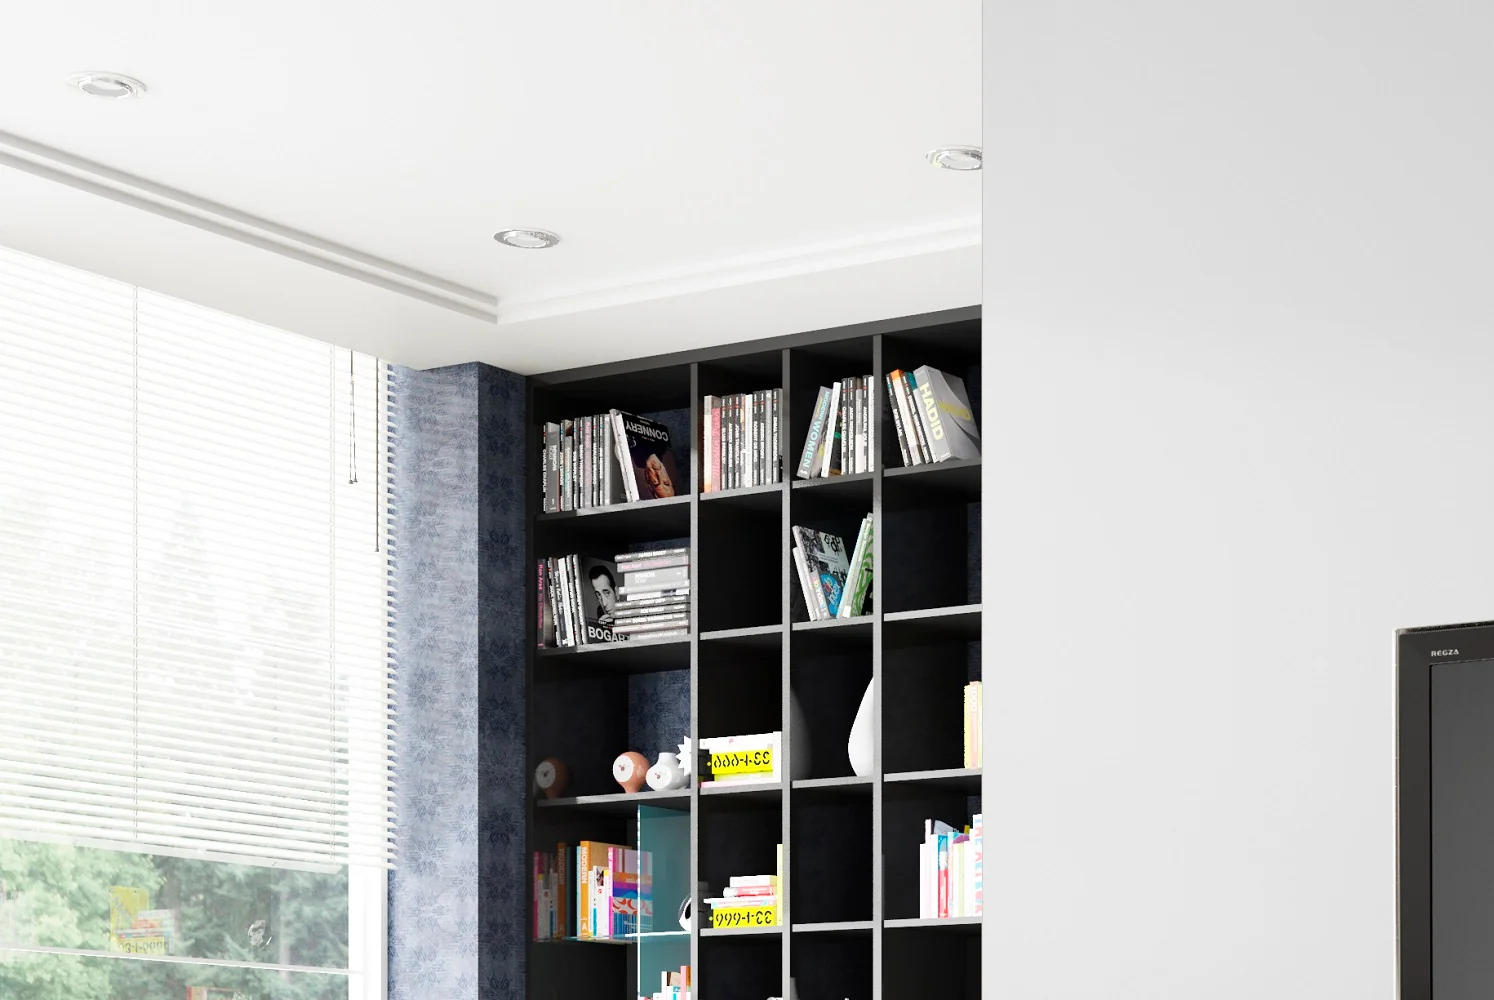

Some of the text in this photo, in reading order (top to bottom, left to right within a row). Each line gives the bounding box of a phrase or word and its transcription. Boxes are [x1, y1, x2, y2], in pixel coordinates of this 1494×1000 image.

[818, 391, 830, 420] MODERN
[920, 383, 943, 440] HADID
[626, 420, 668, 441] CONNERY
[802, 420, 821, 468] WOMEN
[588, 626, 629, 642] BOGAR
